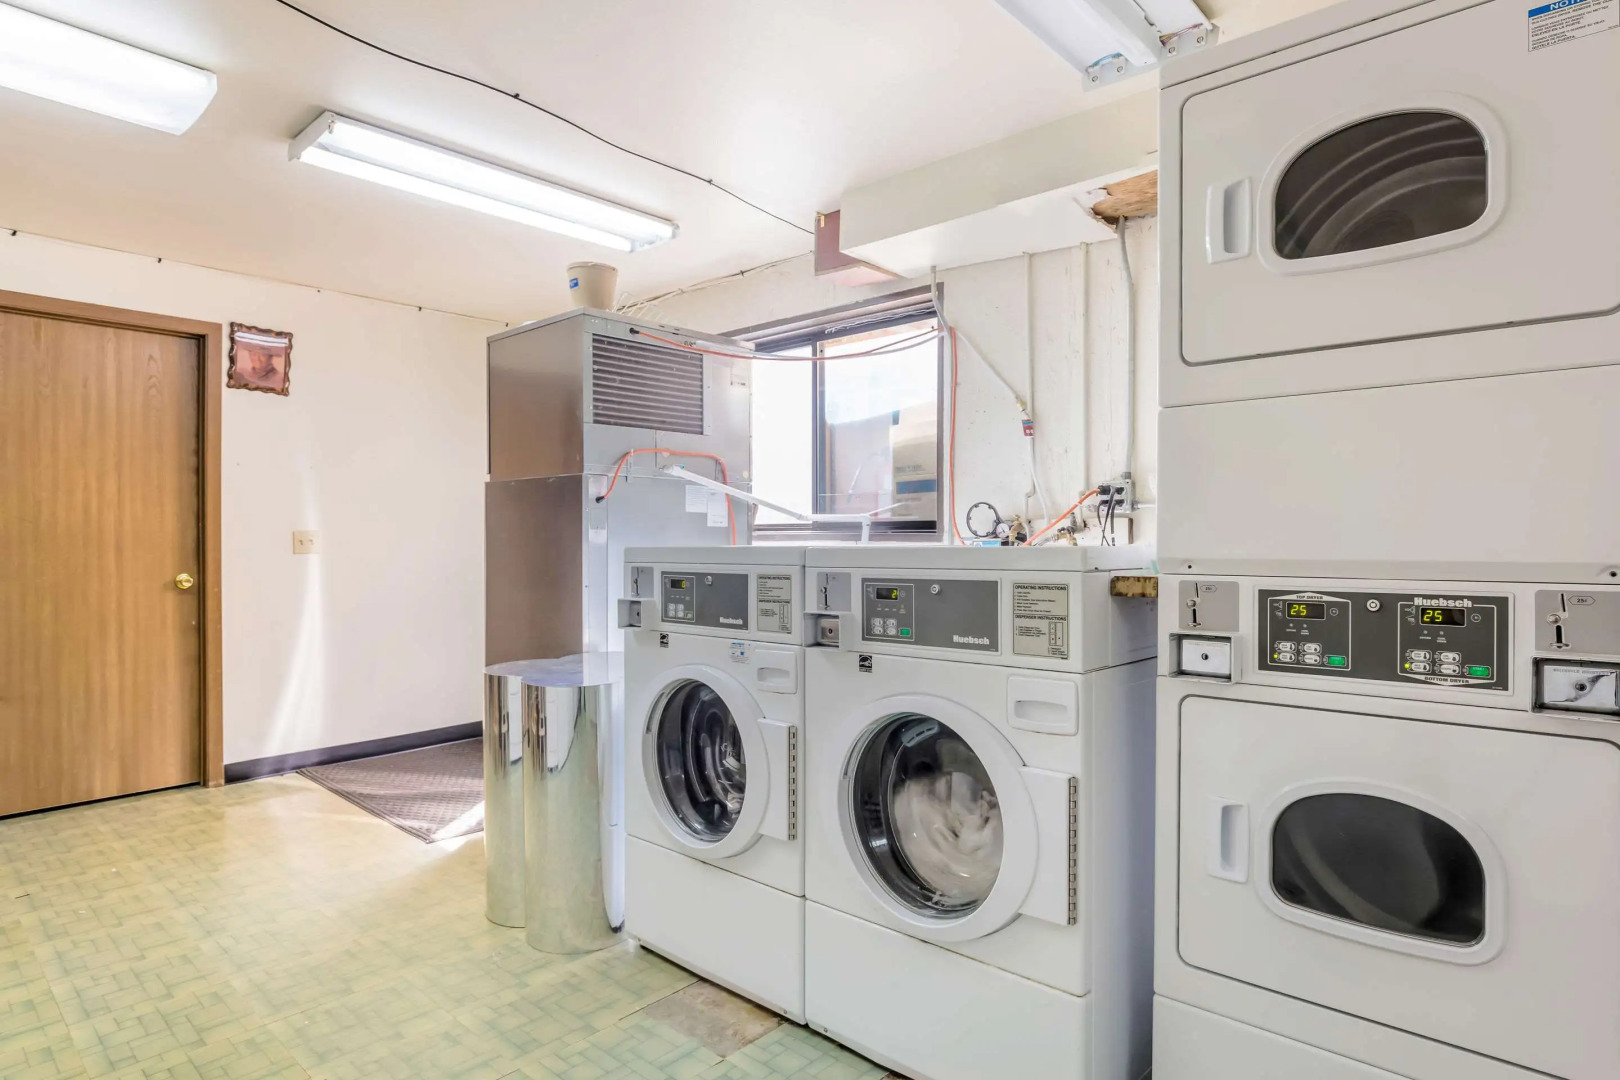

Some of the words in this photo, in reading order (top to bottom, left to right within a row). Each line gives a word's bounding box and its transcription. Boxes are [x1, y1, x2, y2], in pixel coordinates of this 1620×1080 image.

[1414, 597, 1472, 607] Huebsch
[1290, 604, 1307, 615] 25
[1424, 610, 1442, 621] 25
[953, 635, 990, 645] Huebsch
